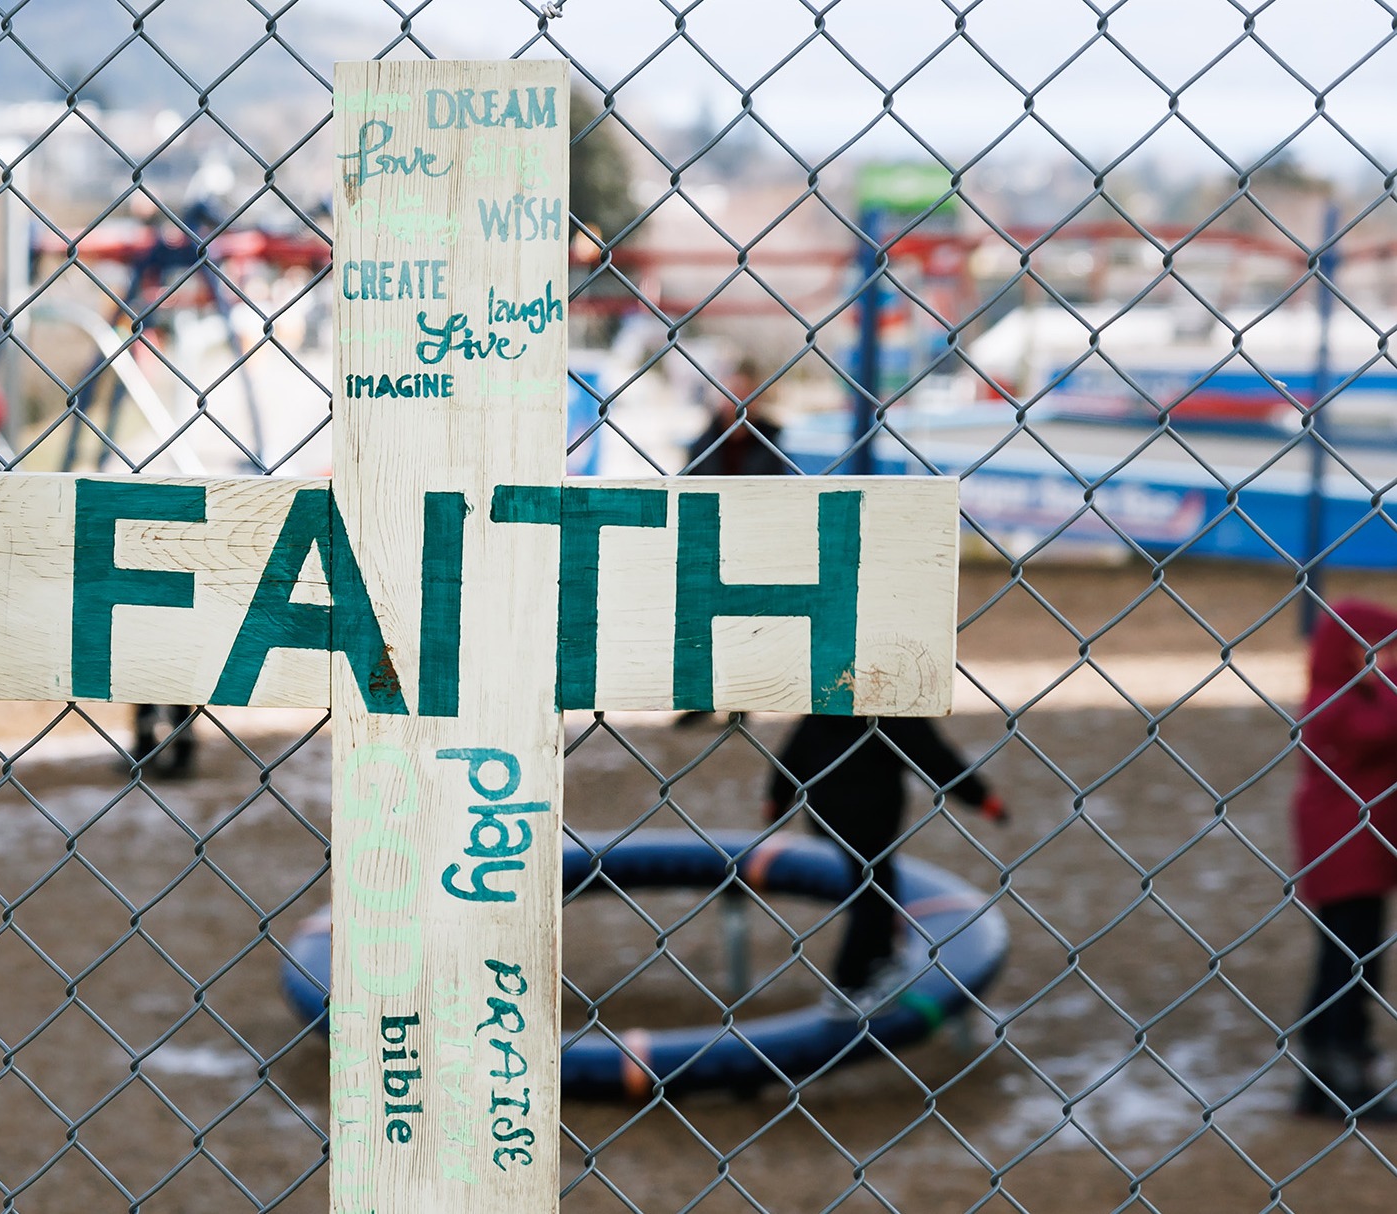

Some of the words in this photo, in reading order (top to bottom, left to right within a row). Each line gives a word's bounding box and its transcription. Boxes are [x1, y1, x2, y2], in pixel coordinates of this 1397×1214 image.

[336, 119, 453, 186] Love
[426, 87, 556, 129] DREAM
[343, 260, 447, 301] CREATE
[488, 280, 563, 334] laugh
[416, 311, 527, 364] Live
[71, 478, 863, 717] FAITH
[343, 744, 421, 997] GOD
[436, 748, 550, 902] play
[381, 1012, 422, 1144] bible
[475, 958, 535, 1171] PRAISE
